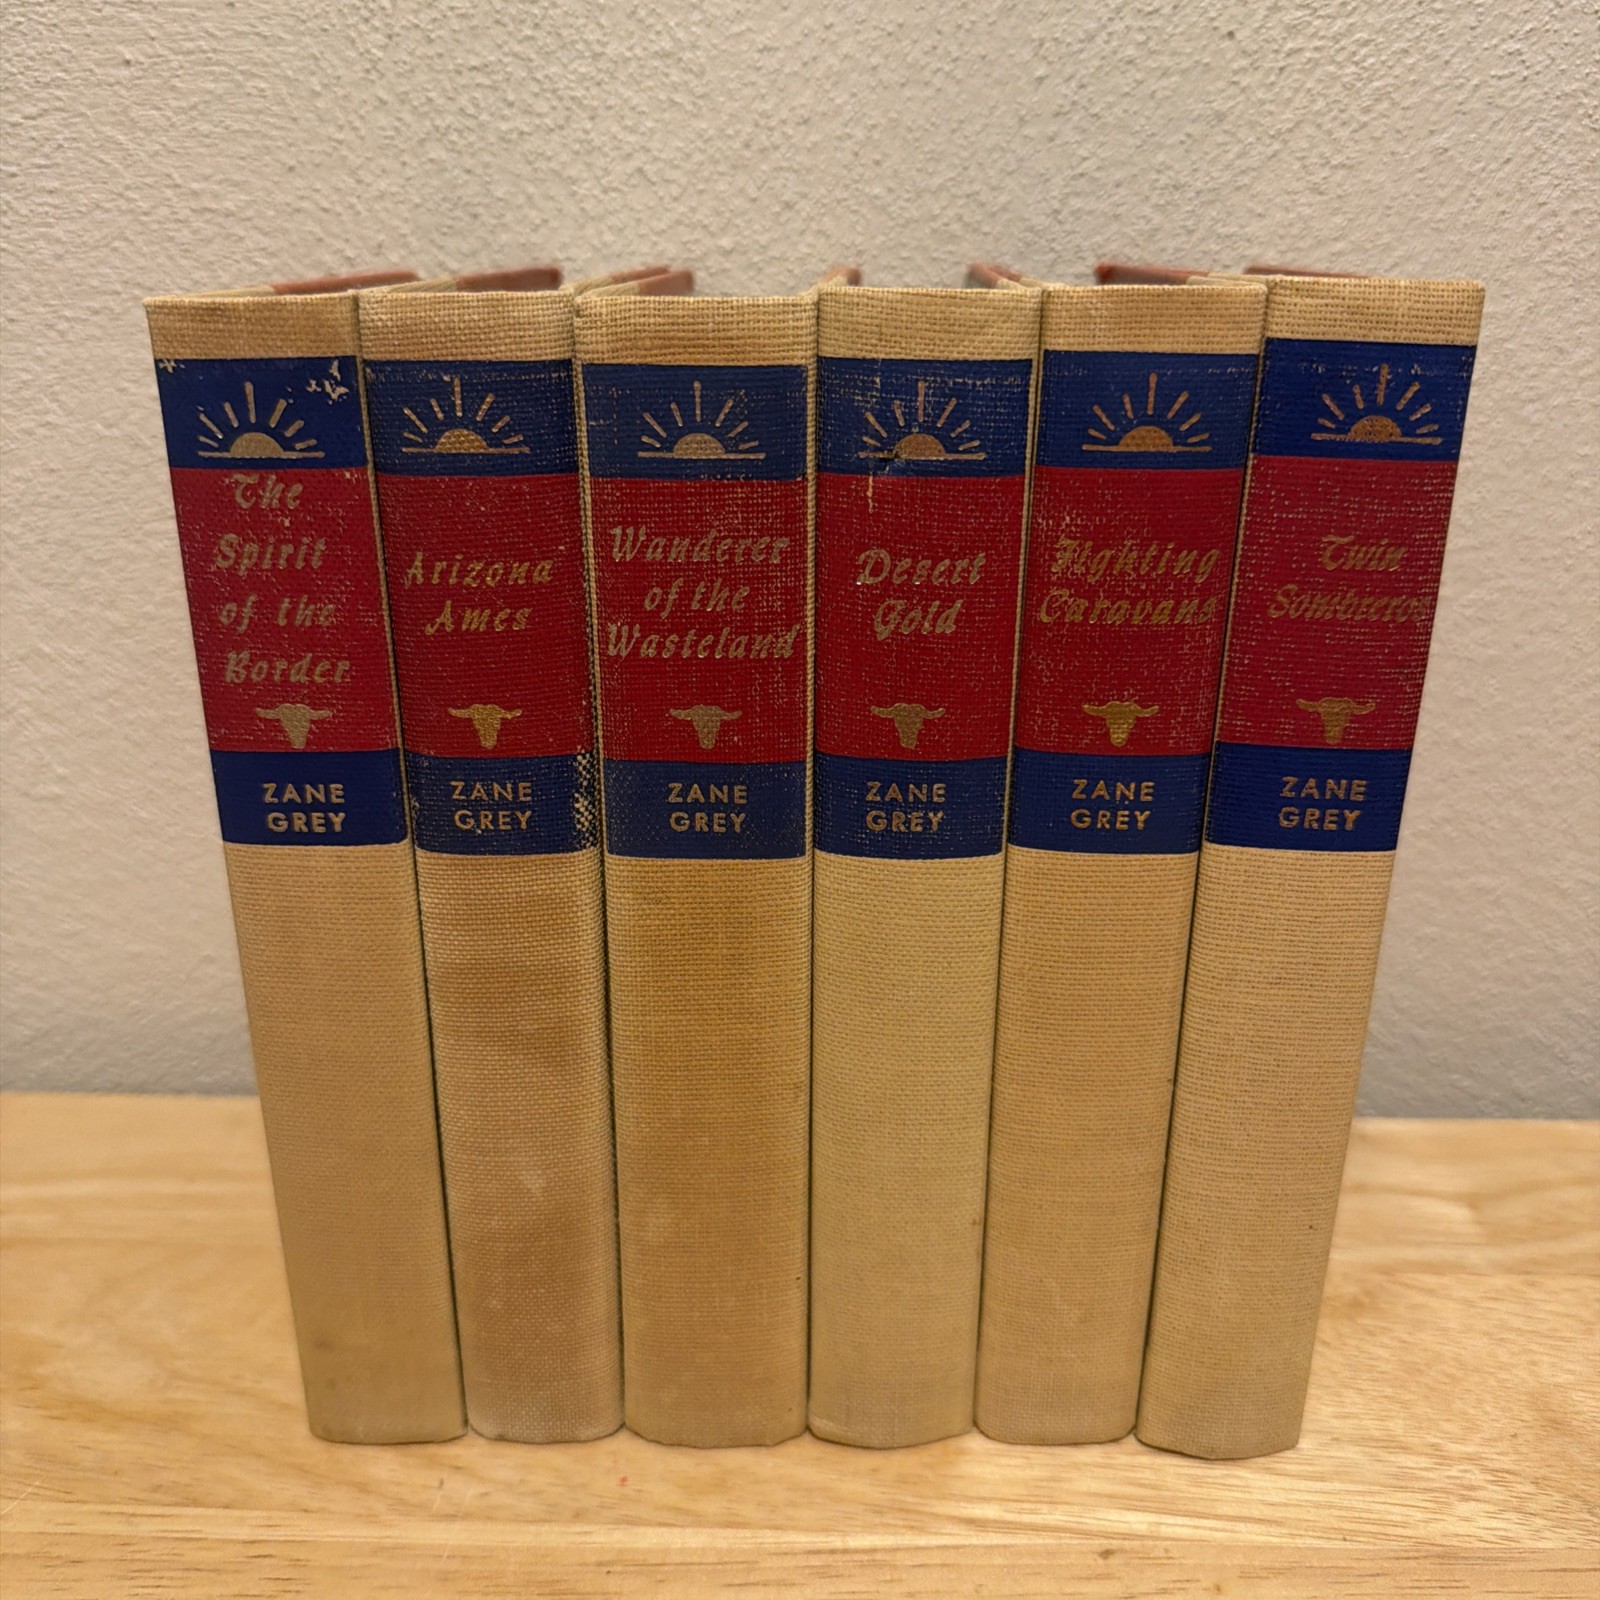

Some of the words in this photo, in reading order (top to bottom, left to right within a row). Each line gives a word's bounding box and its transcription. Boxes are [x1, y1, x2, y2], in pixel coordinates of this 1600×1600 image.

[230, 473, 304, 509] The
[214, 533, 327, 576] Spirit
[610, 525, 790, 564] Wanderer
[1051, 534, 1220, 583] Fighting
[1321, 534, 1407, 572] Twin
[405, 552, 553, 587] Arizona
[857, 549, 986, 586] Desert
[219, 594, 258, 633] of
[276, 595, 336, 628] the
[643, 578, 679, 619] of
[690, 577, 750, 611] the
[1038, 588, 1216, 625] Caravans
[1267, 583, 1430, 623] Sombreros
[424, 601, 532, 635] Ames
[873, 598, 964, 640] Gold
[607, 622, 799, 659] Wasteland
[224, 651, 350, 684] Border
[263, 783, 345, 804] ZANE
[451, 781, 532, 801] ZANE
[668, 782, 748, 804] ZANE
[866, 781, 946, 803] ZANE
[1072, 779, 1155, 802] ZANE
[1280, 777, 1367, 801] ZANE
[267, 812, 346, 833] GREY
[453, 810, 532, 831] GREY
[669, 812, 746, 833] GREY
[866, 811, 944, 833] GREY
[1070, 808, 1151, 831] GREY
[1279, 806, 1360, 831] GREY
